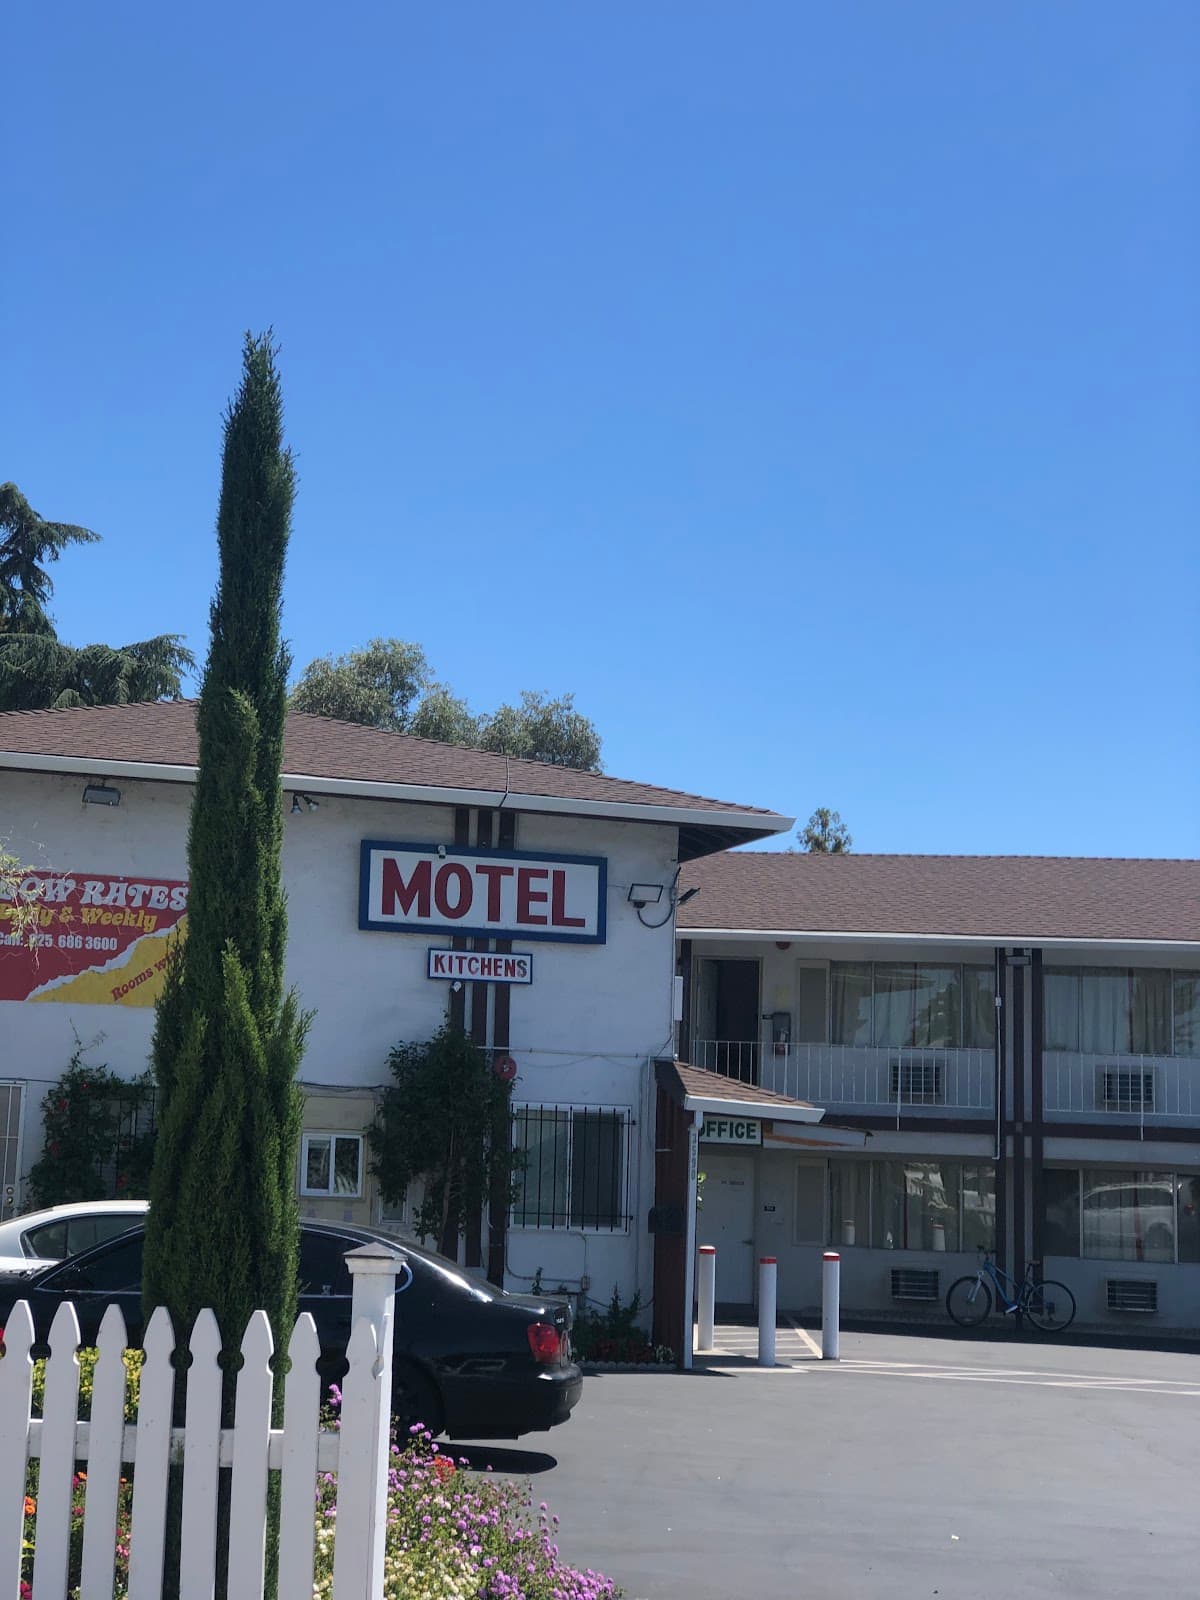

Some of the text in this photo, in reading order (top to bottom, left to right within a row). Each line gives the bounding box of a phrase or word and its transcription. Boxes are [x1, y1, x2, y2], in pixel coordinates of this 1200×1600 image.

[79, 881, 189, 911] RATES
[382, 858, 586, 928] MOTEL
[59, 906, 75, 923] &
[80, 907, 158, 933] Weekly
[85, 936, 118, 951] 3600
[434, 954, 528, 978] KITCHENS
[111, 967, 154, 1001] Rooms
